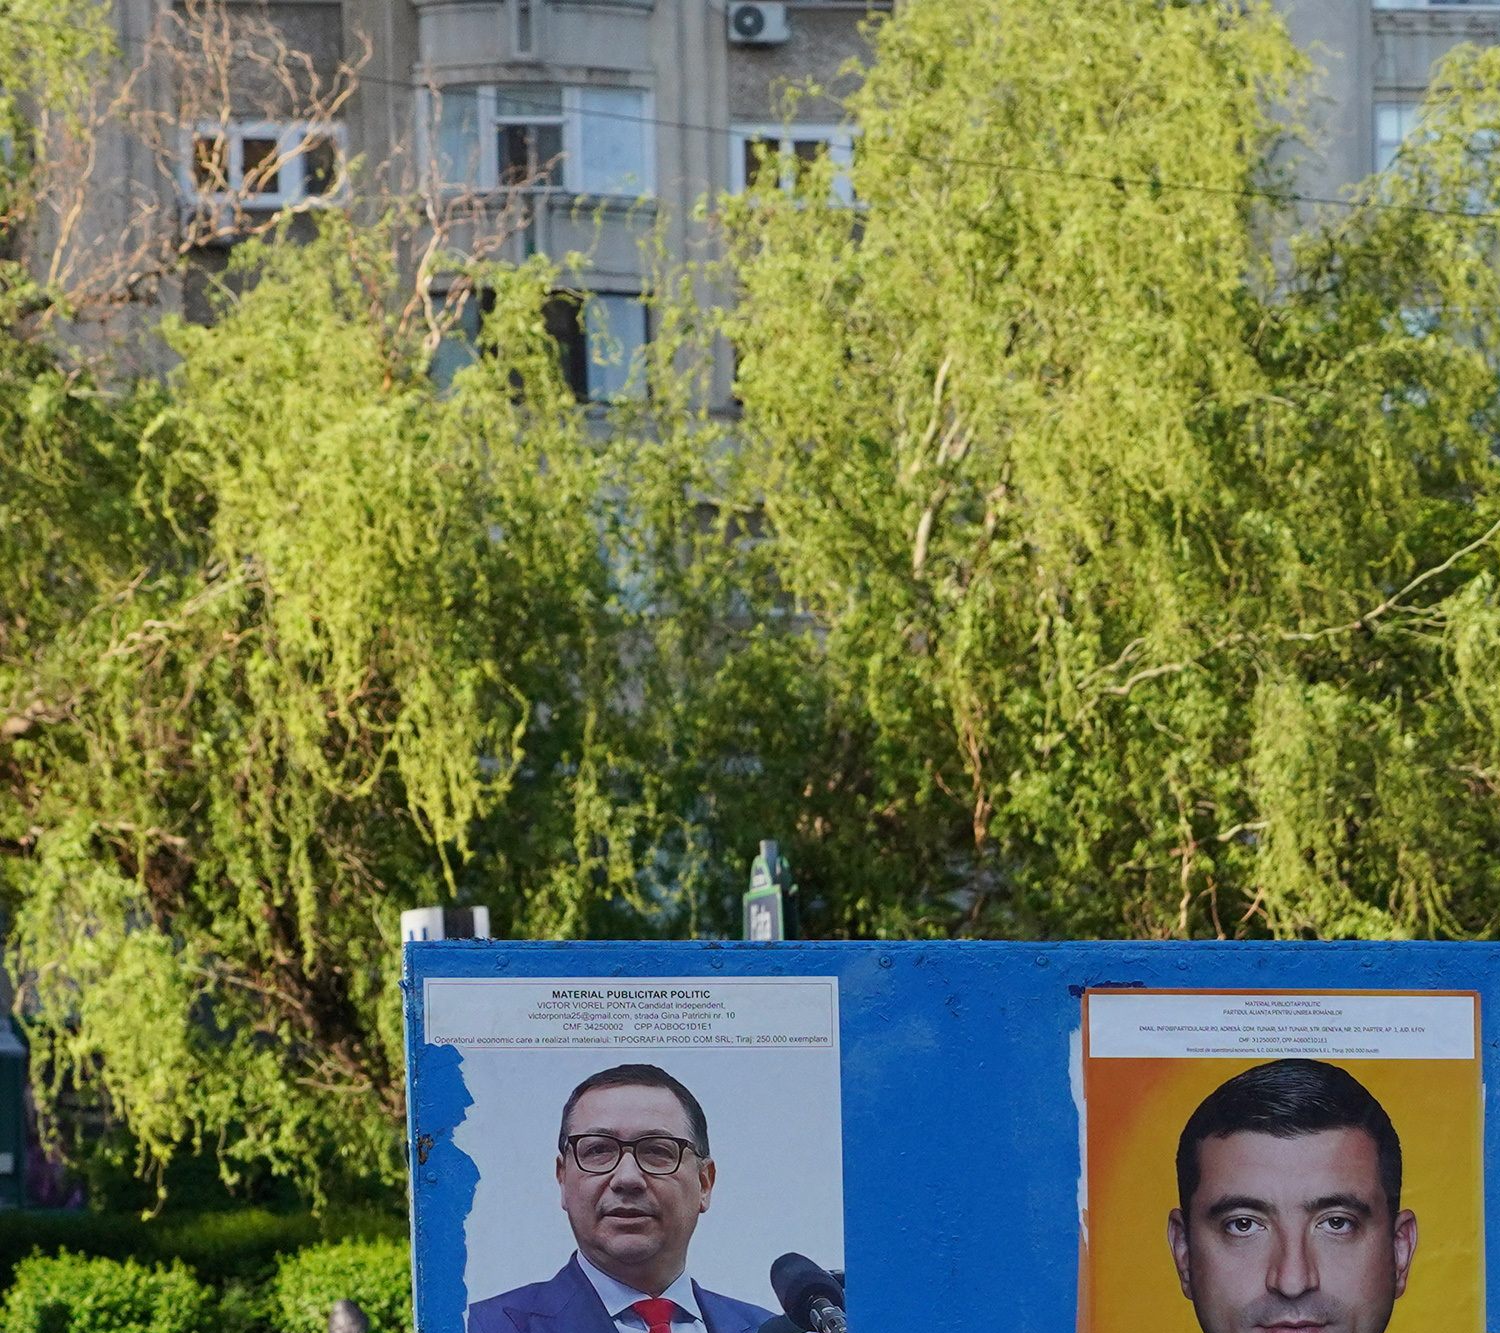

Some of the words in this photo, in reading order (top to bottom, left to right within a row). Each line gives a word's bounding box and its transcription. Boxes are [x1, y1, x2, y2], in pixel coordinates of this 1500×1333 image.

[552, 990, 604, 999] MATERIAL
[607, 990, 668, 999] PUBLICITAR
[670, 990, 711, 999] POLITIC
[638, 1001, 673, 1009] Candidat
